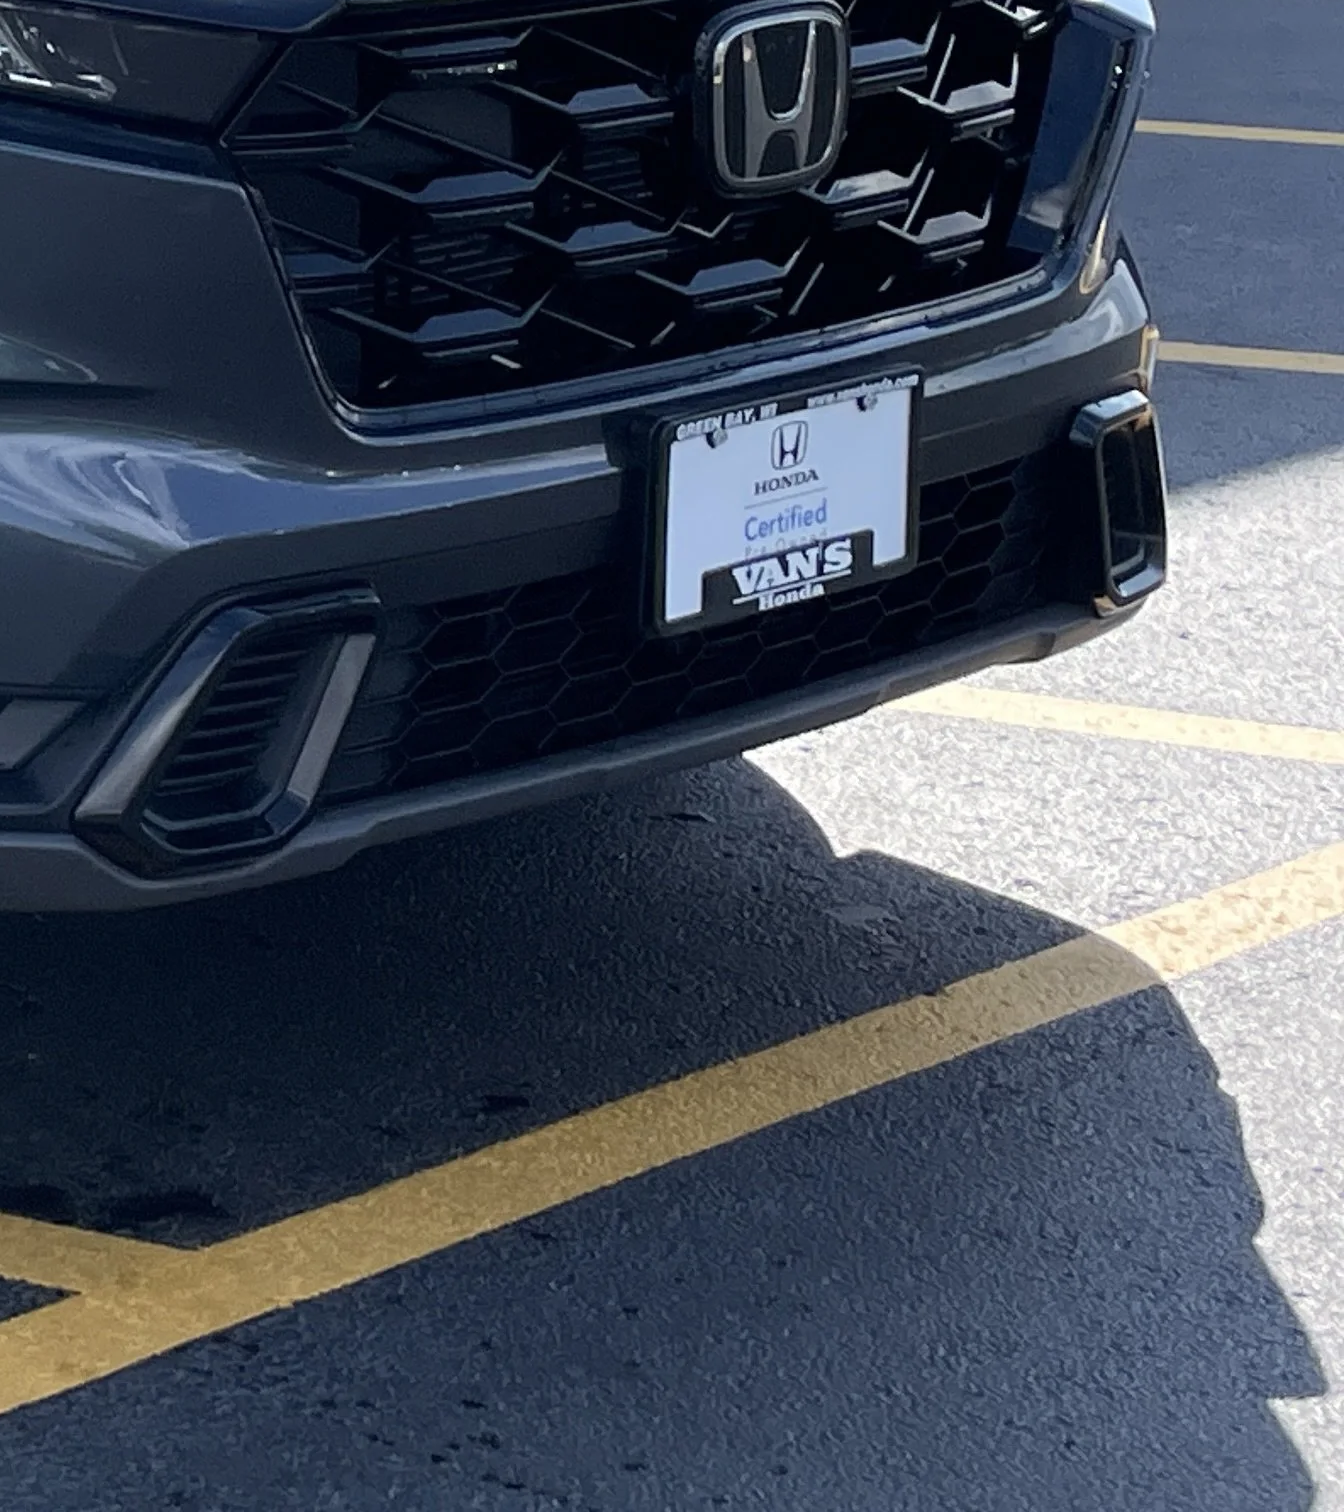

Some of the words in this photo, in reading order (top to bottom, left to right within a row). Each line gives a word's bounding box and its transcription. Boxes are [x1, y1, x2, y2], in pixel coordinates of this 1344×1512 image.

[753, 468, 820, 496] HONDA
[743, 497, 828, 542] Certified
[758, 583, 826, 612] Honda
